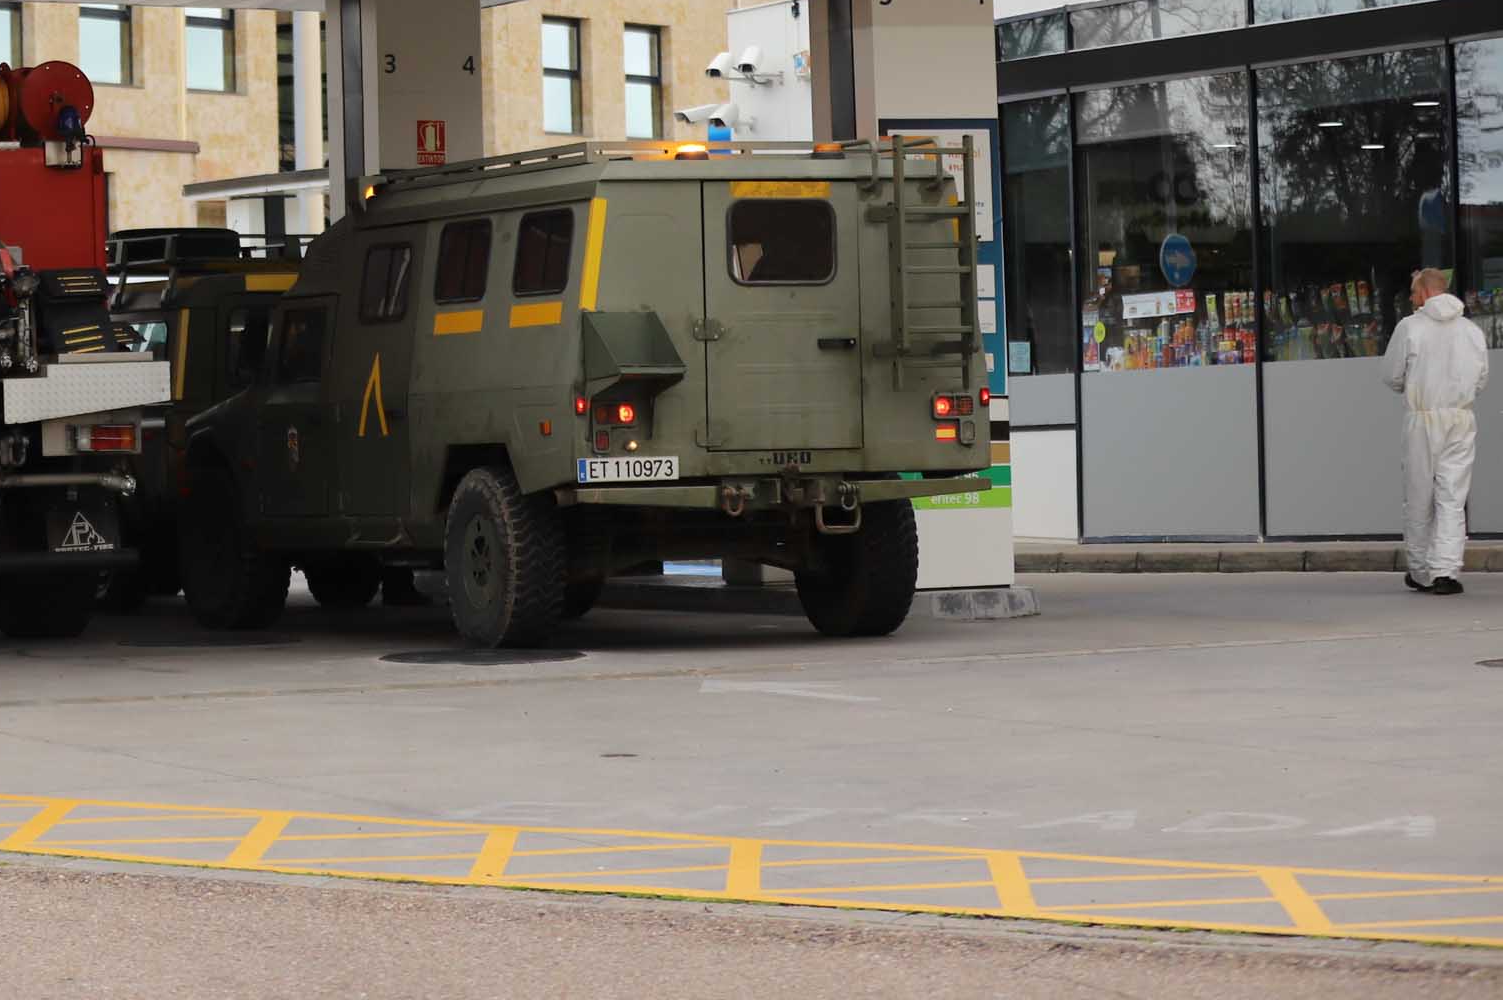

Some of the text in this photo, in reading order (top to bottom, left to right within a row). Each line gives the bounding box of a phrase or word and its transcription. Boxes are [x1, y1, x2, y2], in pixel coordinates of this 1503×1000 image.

[384, 53, 396, 74] 3
[462, 55, 476, 75] 4
[589, 459, 674, 479] ET 110973
